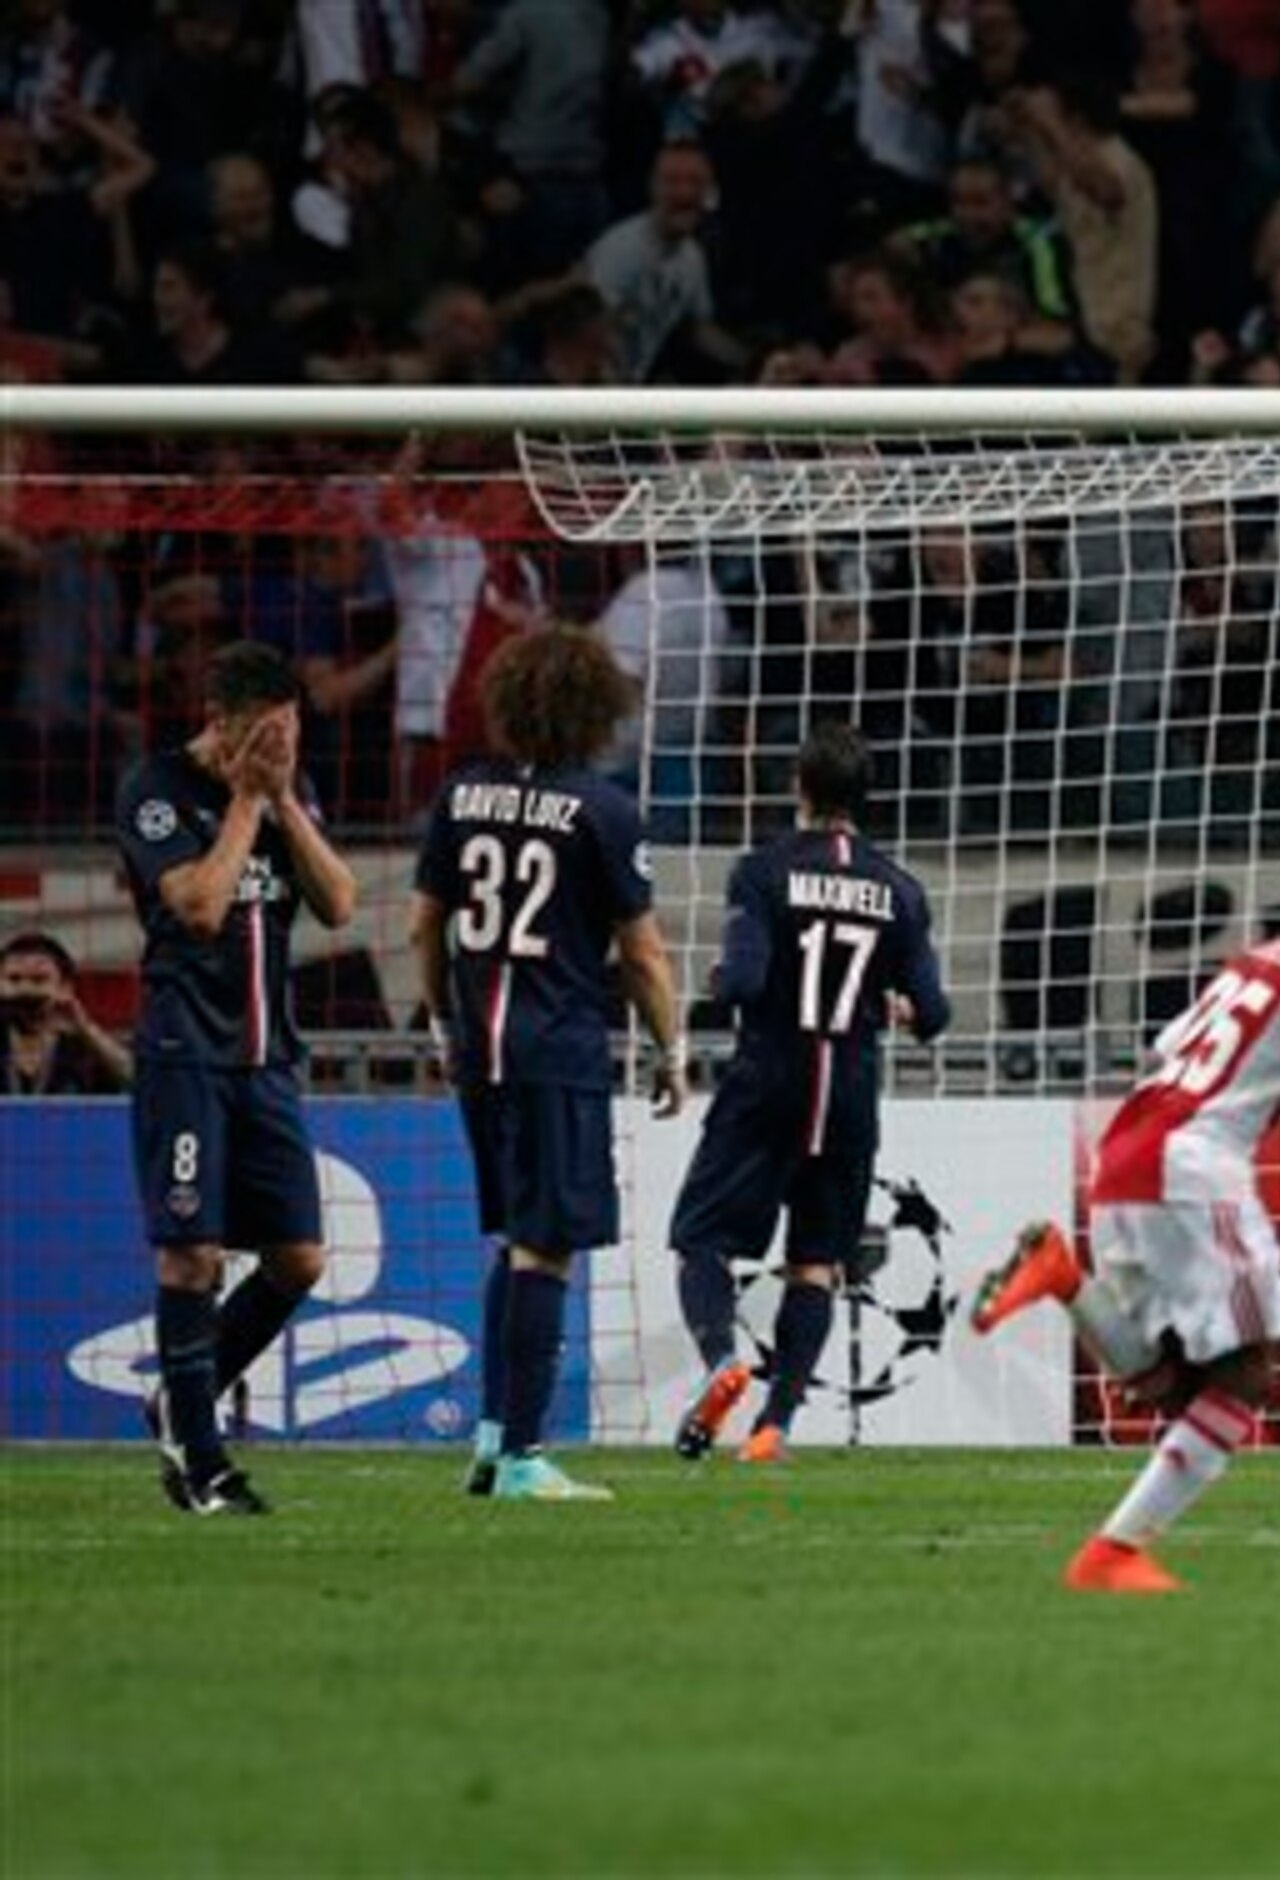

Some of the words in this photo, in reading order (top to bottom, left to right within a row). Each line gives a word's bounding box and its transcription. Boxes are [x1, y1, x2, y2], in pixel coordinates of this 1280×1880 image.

[453, 784, 521, 822] DAVID
[523, 788, 582, 833] LUIZ
[458, 834, 557, 956] 32
[788, 871, 895, 921] MAXWELL
[798, 918, 879, 1034] 17
[173, 1132, 199, 1182] 8
